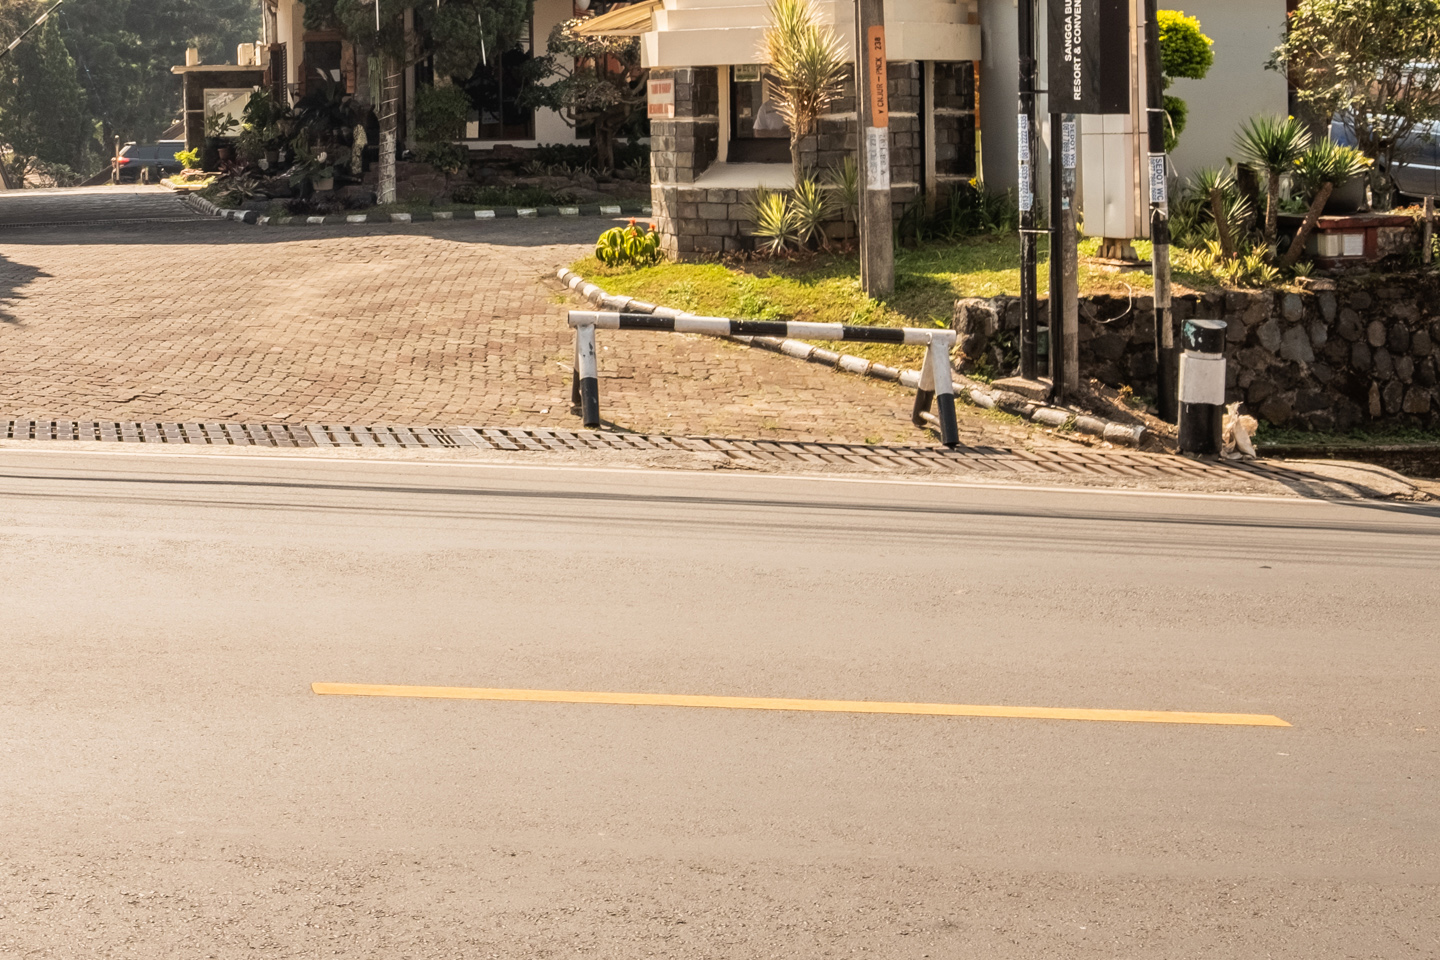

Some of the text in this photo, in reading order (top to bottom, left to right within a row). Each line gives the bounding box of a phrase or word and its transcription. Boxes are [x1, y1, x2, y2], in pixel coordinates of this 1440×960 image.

[874, 37, 882, 50] 238
[1064, 15, 1072, 61] SANGGA
[1074, 46, 1081, 55] &
[1073, 57, 1082, 100] RESORT
[1070, 153, 1076, 167] WC
[1155, 158, 1164, 201] SEDOT WC
